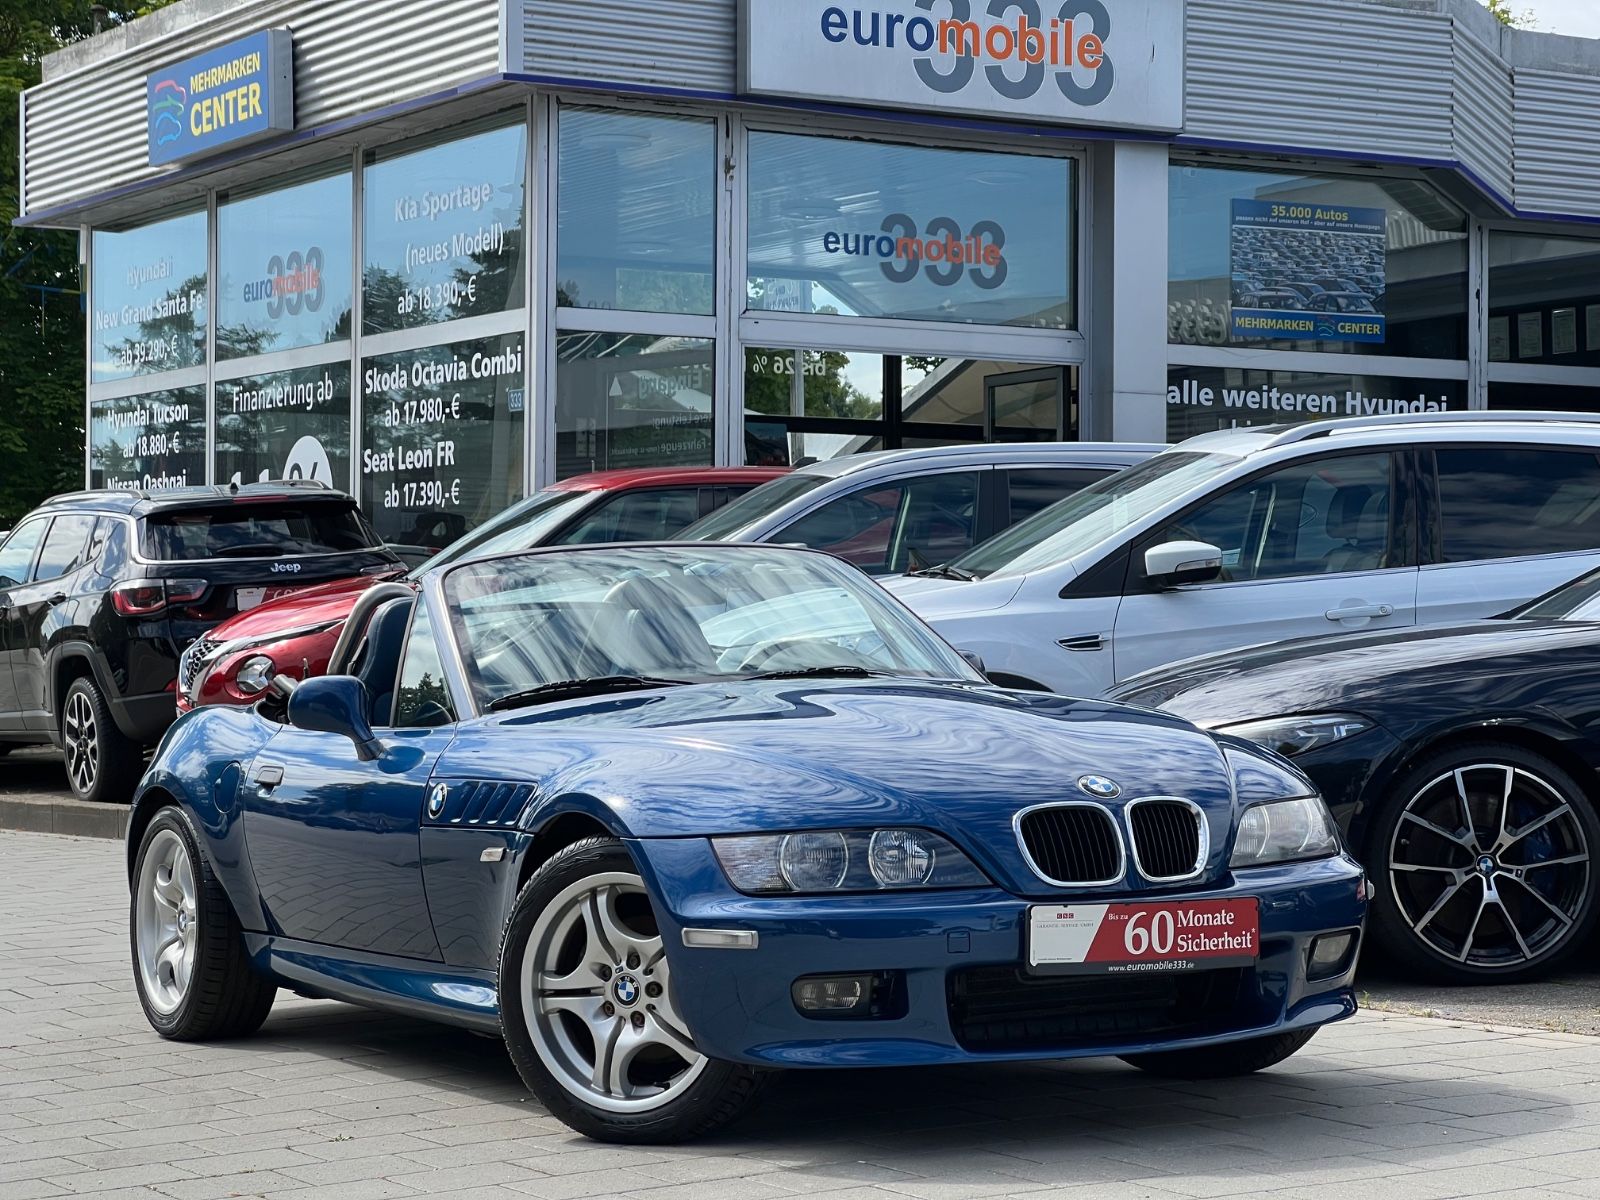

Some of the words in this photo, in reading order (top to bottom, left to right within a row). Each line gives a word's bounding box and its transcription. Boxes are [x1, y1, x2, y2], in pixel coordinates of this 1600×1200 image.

[820, 5, 1104, 69] euromobile
[912, 0, 1115, 106] 333
[190, 51, 260, 95] MEHRMARKEN
[190, 82, 262, 136] CENTER
[395, 196, 417, 222] Kia
[422, 182, 491, 221] Sportage
[1271, 205, 1312, 218] 35.000
[1315, 209, 1348, 221] Autos
[406, 242, 448, 273] (neues
[452, 222, 504, 257] Modell)
[823, 231, 1000, 266] euromobile
[880, 213, 1008, 290] 333
[243, 263, 319, 303] euromobile
[266, 246, 324, 320] 333
[96, 309, 118, 330] New
[121, 299, 153, 324] Grand
[156, 293, 187, 319] Santa
[190, 290, 203, 311] Fe
[397, 290, 413, 314] ab
[1236, 316, 1313, 332] MEHRMARKEN
[1338, 322, 1380, 335] CENTER
[121, 344, 132, 366] ab
[365, 364, 407, 394] Skoda
[412, 355, 467, 387] Octavia
[471, 345, 522, 379] Combi
[233, 380, 314, 413] Finanzierung
[317, 371, 333, 402] ab
[1167, 379, 1214, 406] alle
[1223, 385, 1337, 414] weiteren
[107, 404, 150, 434] Hyundai
[152, 403, 189, 424] Tucson
[385, 402, 399, 427] ab
[123, 438, 134, 458] ab
[363, 447, 394, 474] Seat
[398, 446, 432, 471] Leon
[437, 440, 455, 467] FR
[384, 483, 399, 508] ab
[270, 562, 301, 573] Jeep
[1124, 910, 1174, 955] 60
[1177, 909, 1235, 928] Monate
[1108, 960, 1195, 972] www.euromobile333.de
